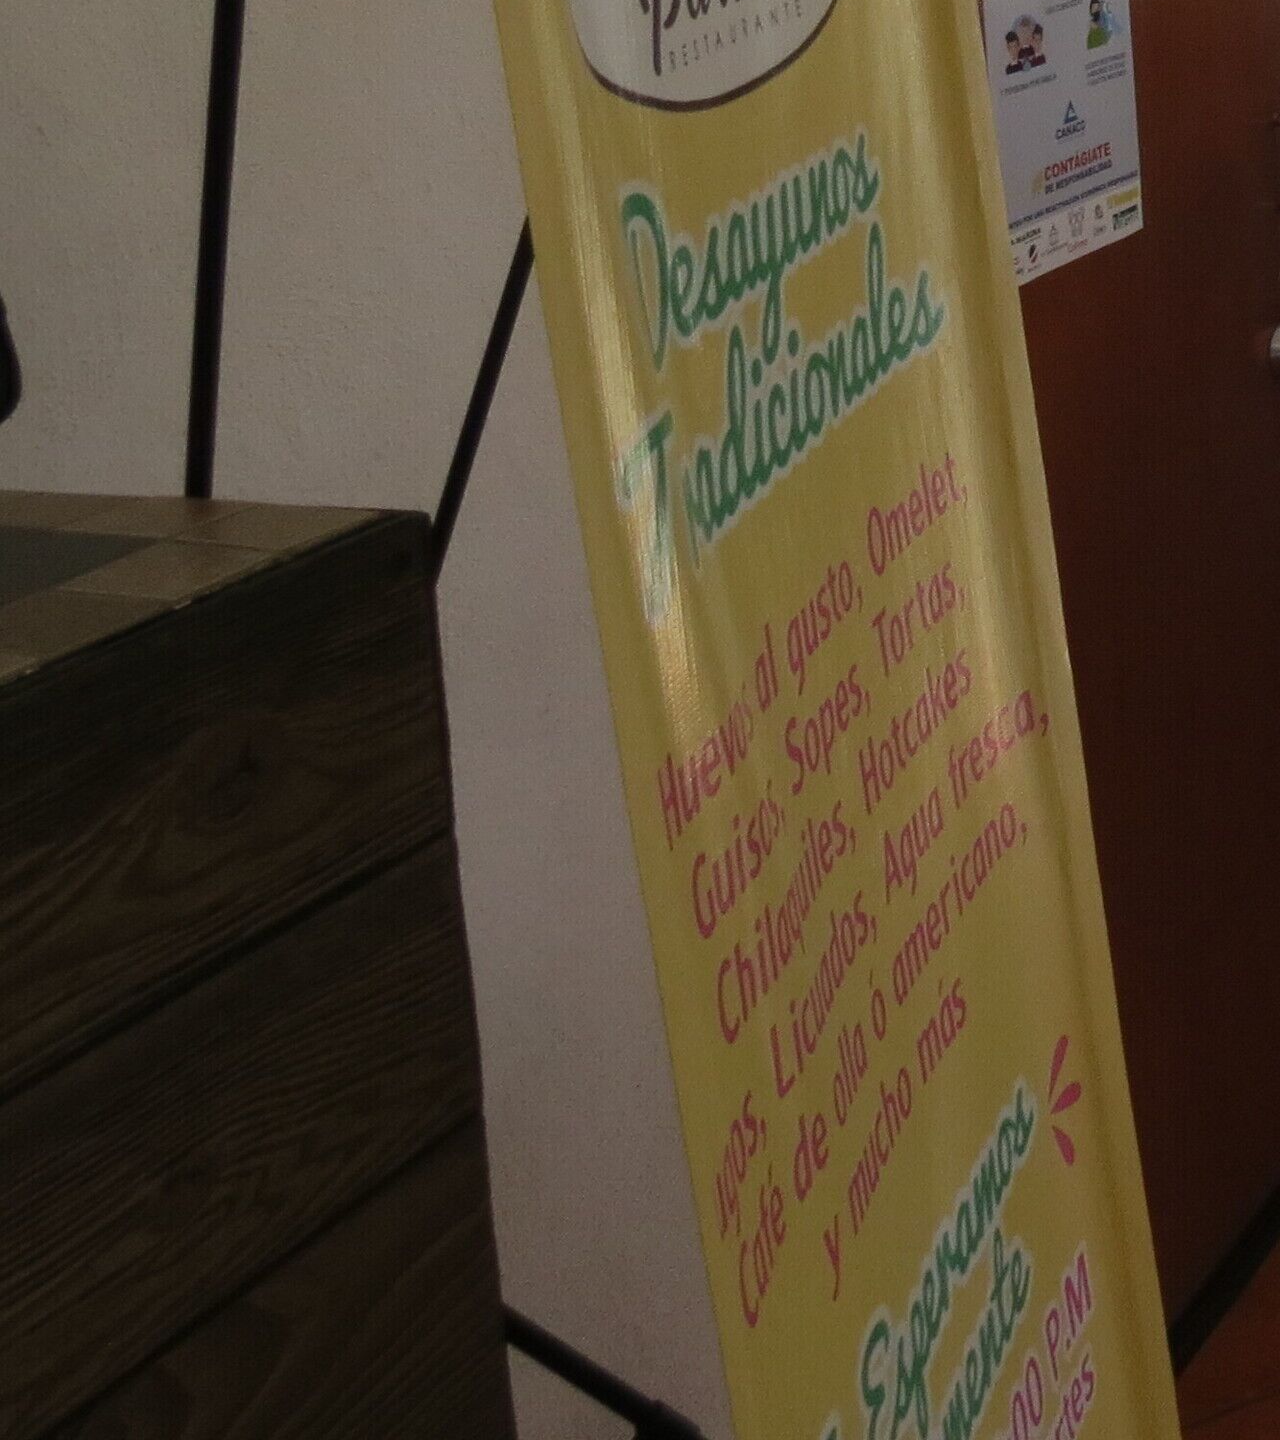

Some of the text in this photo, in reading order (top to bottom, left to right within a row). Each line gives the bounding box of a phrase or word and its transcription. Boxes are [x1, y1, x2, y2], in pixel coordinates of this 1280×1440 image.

[618, 221, 947, 561] Tradicionales
[621, 132, 881, 375] Desayunos
[754, 622, 780, 714] al
[786, 560, 864, 697] gusto,
[866, 452, 968, 577] Omelet,
[784, 663, 871, 796] Sopes,
[871, 561, 966, 678] Tortas,
[717, 648, 974, 1045] Chilaquiles, Hotcakes
[769, 890, 878, 1099] Licuados,
[882, 785, 945, 905] Agua
[948, 689, 1050, 810] fresca,
[738, 1160, 787, 1329] Café
[792, 1111, 830, 1203] de
[833, 1021, 869, 1127] olla
[890, 801, 1030, 1006] americano,
[823, 976, 968, 1303] y mucho más
[860, 1084, 1035, 1440] Esperamos
